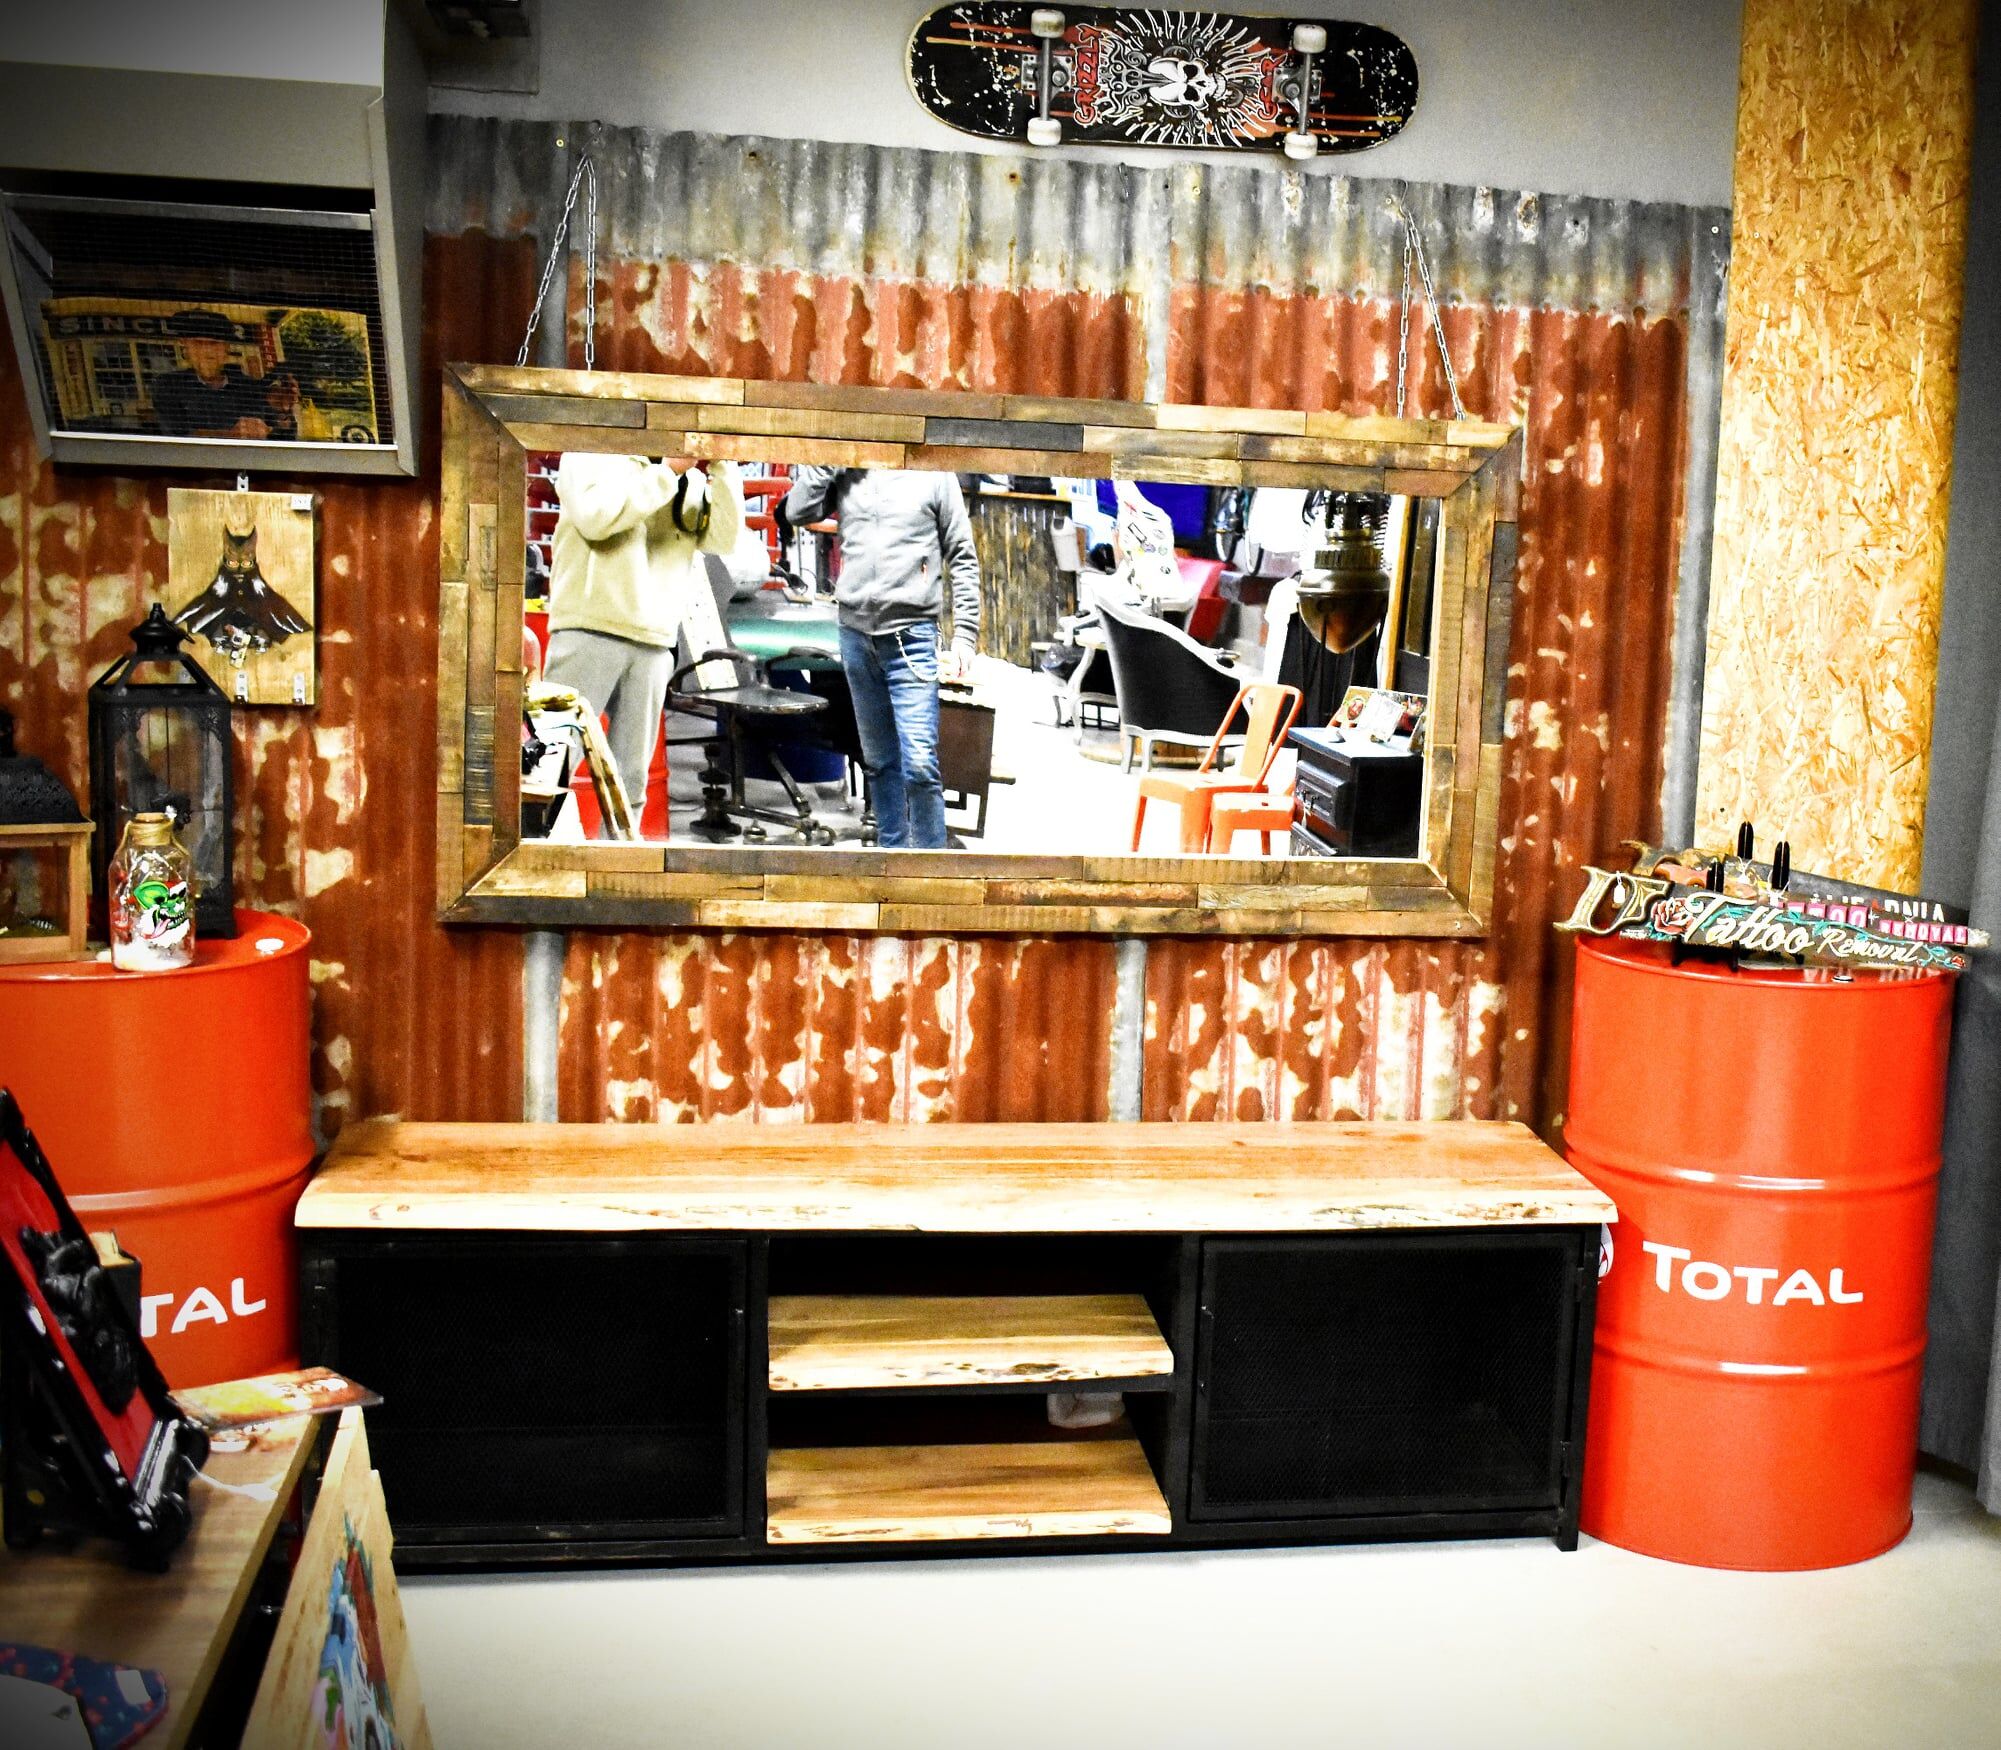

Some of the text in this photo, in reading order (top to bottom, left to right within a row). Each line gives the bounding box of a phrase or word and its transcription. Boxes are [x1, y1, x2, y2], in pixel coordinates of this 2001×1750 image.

[1074, 23, 1101, 124] GRIZZLY
[58, 316, 246, 339] SINCLR
[1684, 891, 1814, 954] Tattoo
[1816, 928, 1924, 963] Removal
[1642, 1240, 1864, 1306] TOTAL
[140, 1277, 267, 1338] TAL
